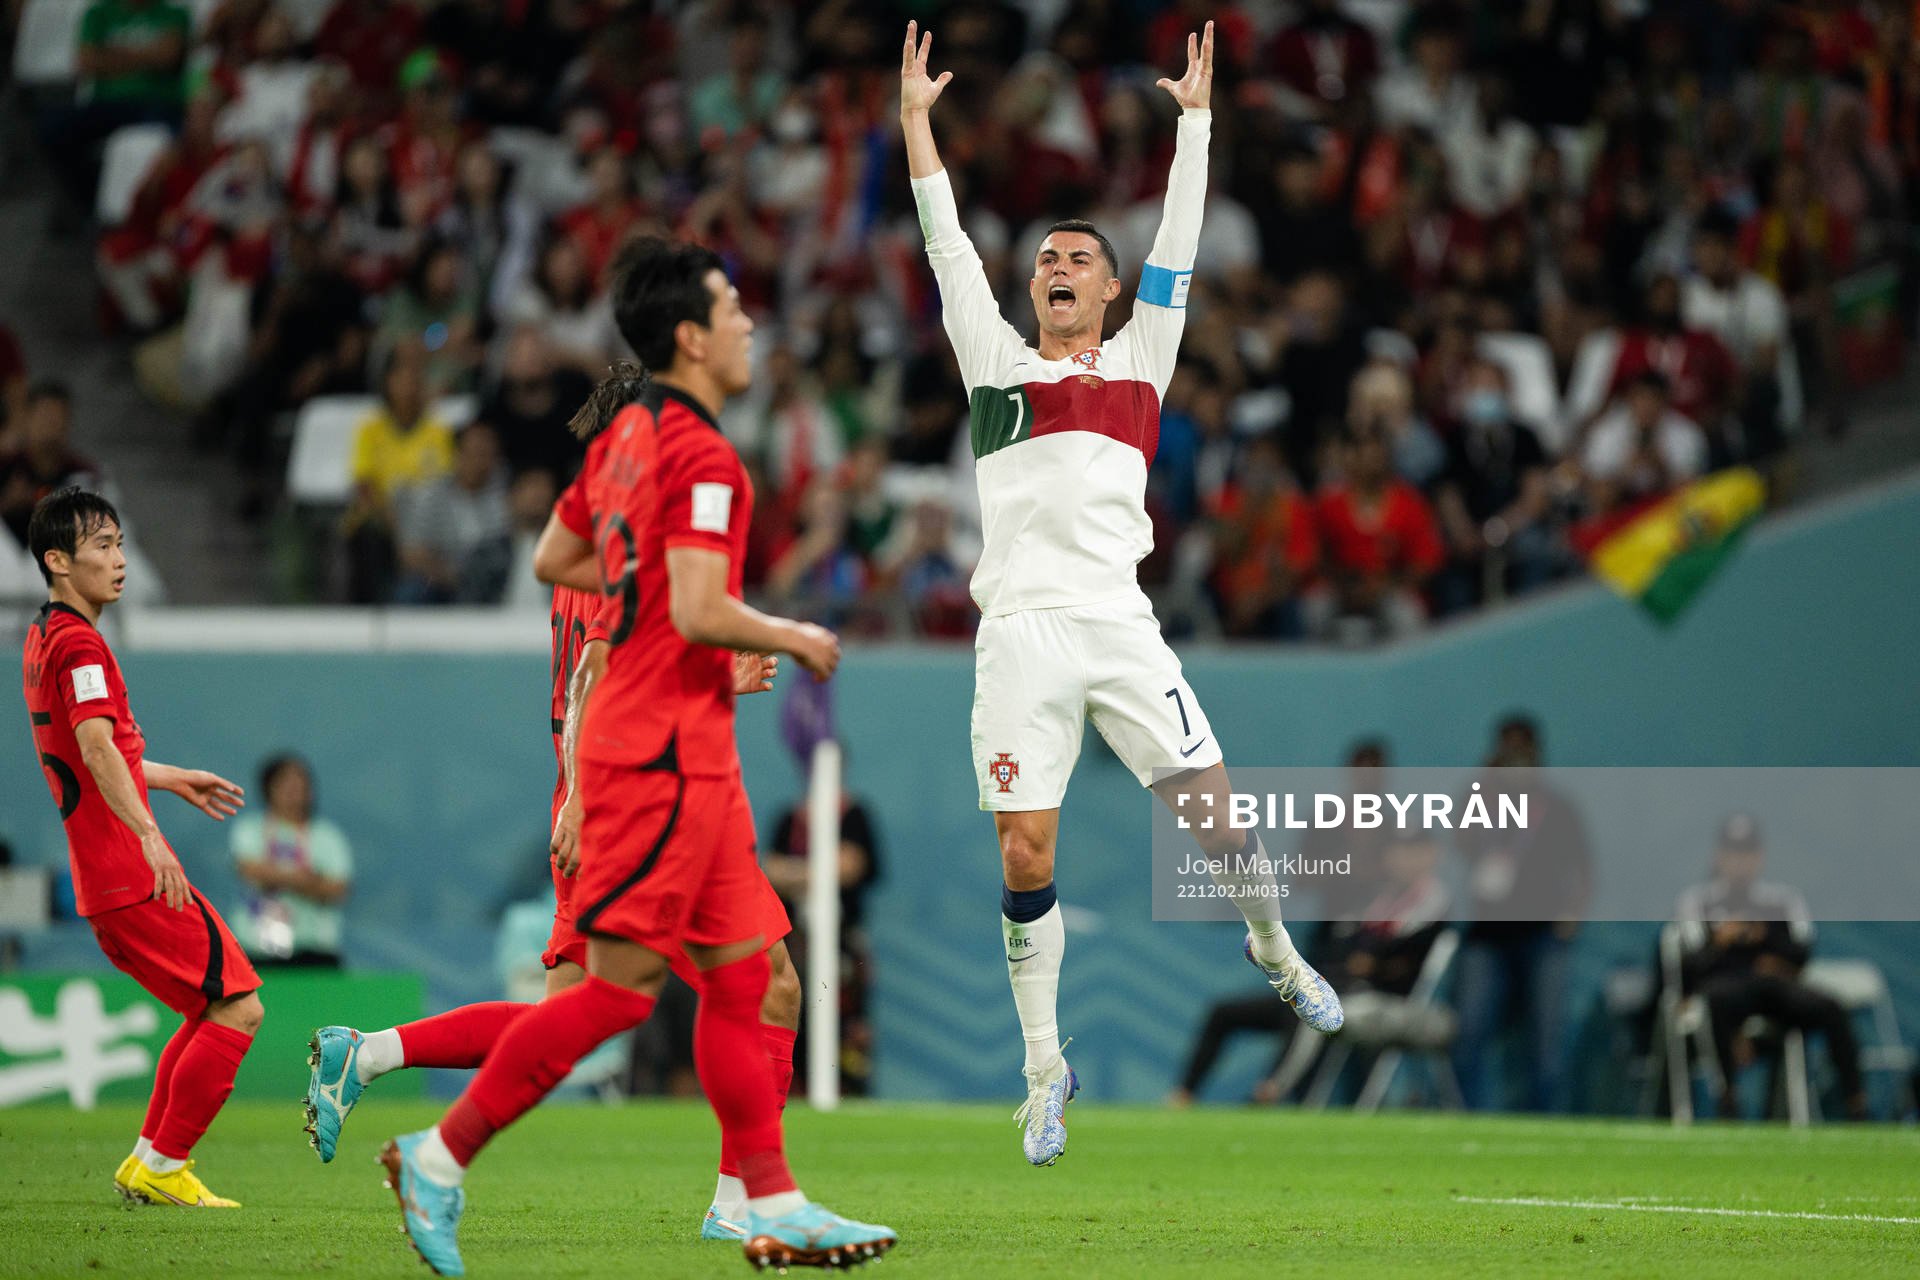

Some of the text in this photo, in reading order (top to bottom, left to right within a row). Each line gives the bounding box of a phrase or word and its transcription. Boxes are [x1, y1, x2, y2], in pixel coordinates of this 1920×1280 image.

[1008, 392, 1024, 440] 7
[591, 511, 638, 645] 9
[1165, 687, 1191, 737] 7
